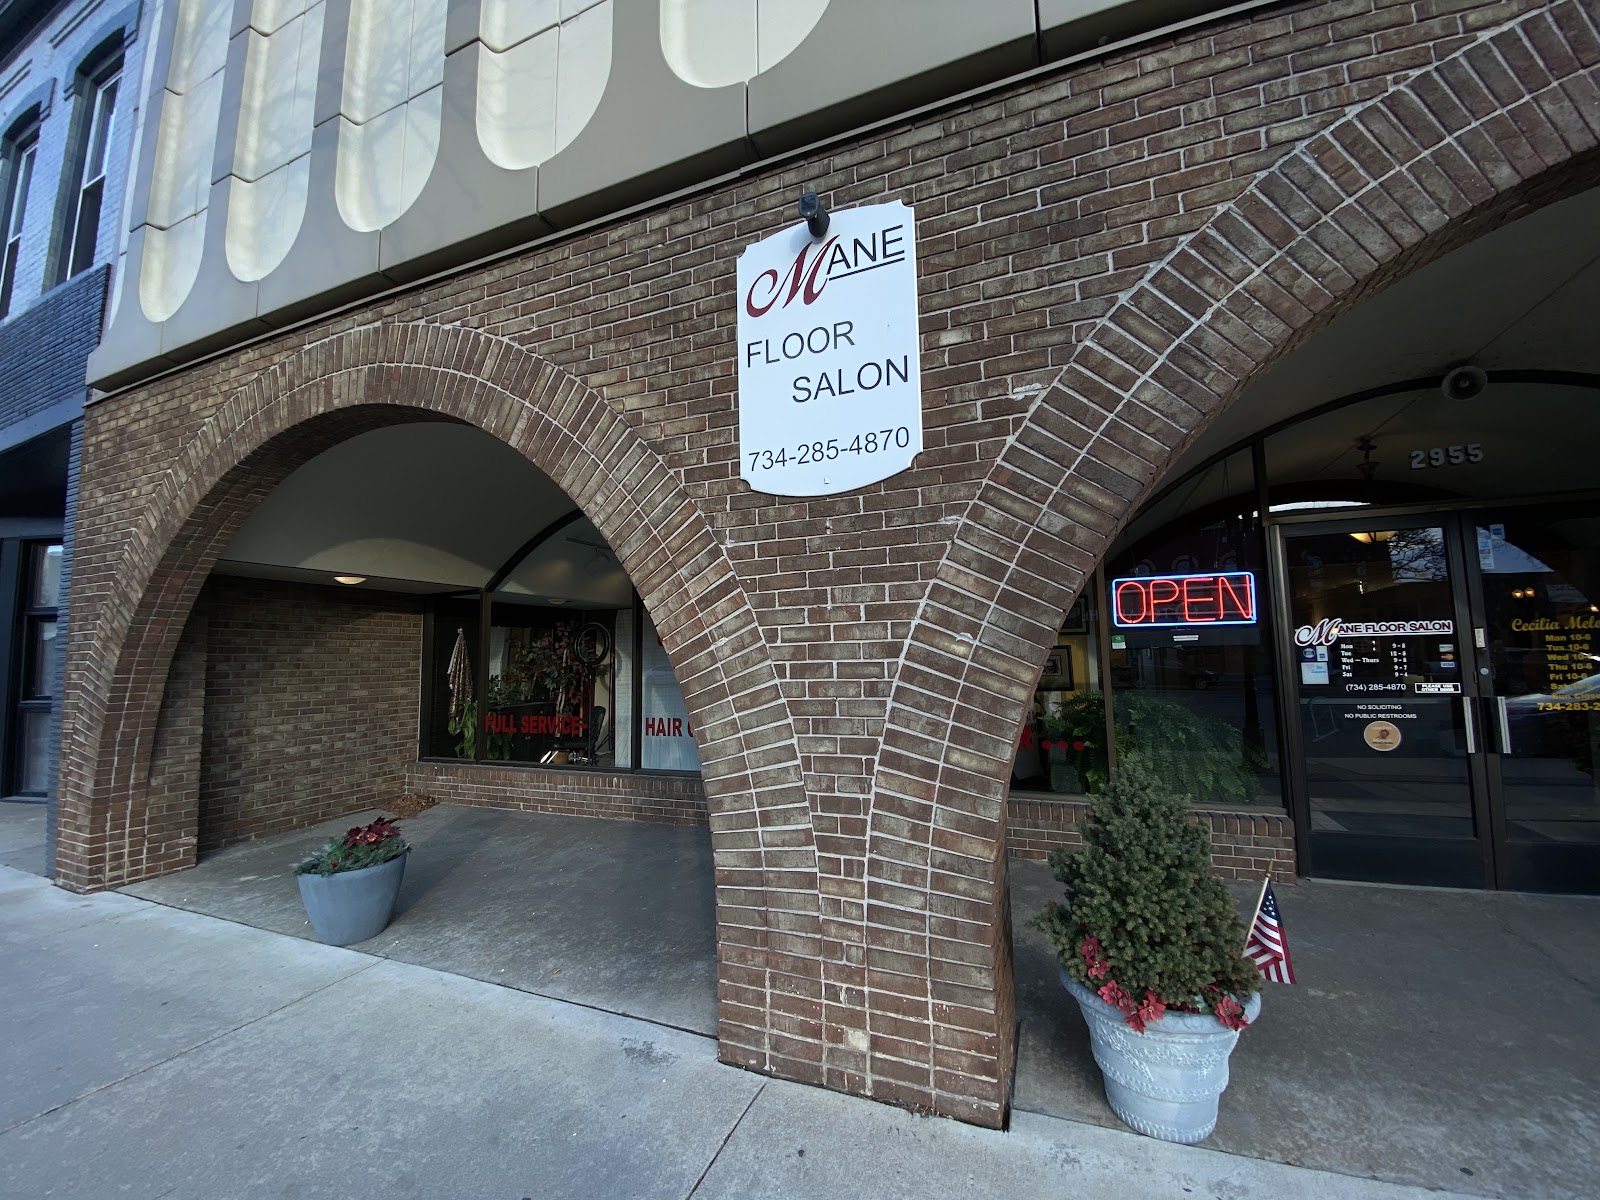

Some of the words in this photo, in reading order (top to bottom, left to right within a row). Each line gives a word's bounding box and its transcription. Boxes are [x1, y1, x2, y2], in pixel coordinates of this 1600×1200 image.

[746, 224, 904, 318] MANE
[747, 320, 855, 368] FLOOR
[792, 355, 909, 403] SALON
[748, 426, 910, 472] 734-285-4870
[1410, 443, 1484, 469] 2955
[1116, 574, 1253, 624] OPEN
[1295, 618, 1362, 646] MANE
[1364, 622, 1406, 634] FLOOR
[1409, 620, 1452, 633] SALON
[1511, 617, 1560, 632] Cecilia
[1546, 653, 1569, 661] Wed
[1345, 683, 1367, 692] (734)
[1368, 683, 1407, 691] 285-4870
[1550, 683, 1566, 691] Sat
[485, 713, 518, 733] FULL
[520, 714, 581, 735] SERVICE
[645, 717, 683, 737] HAIR
